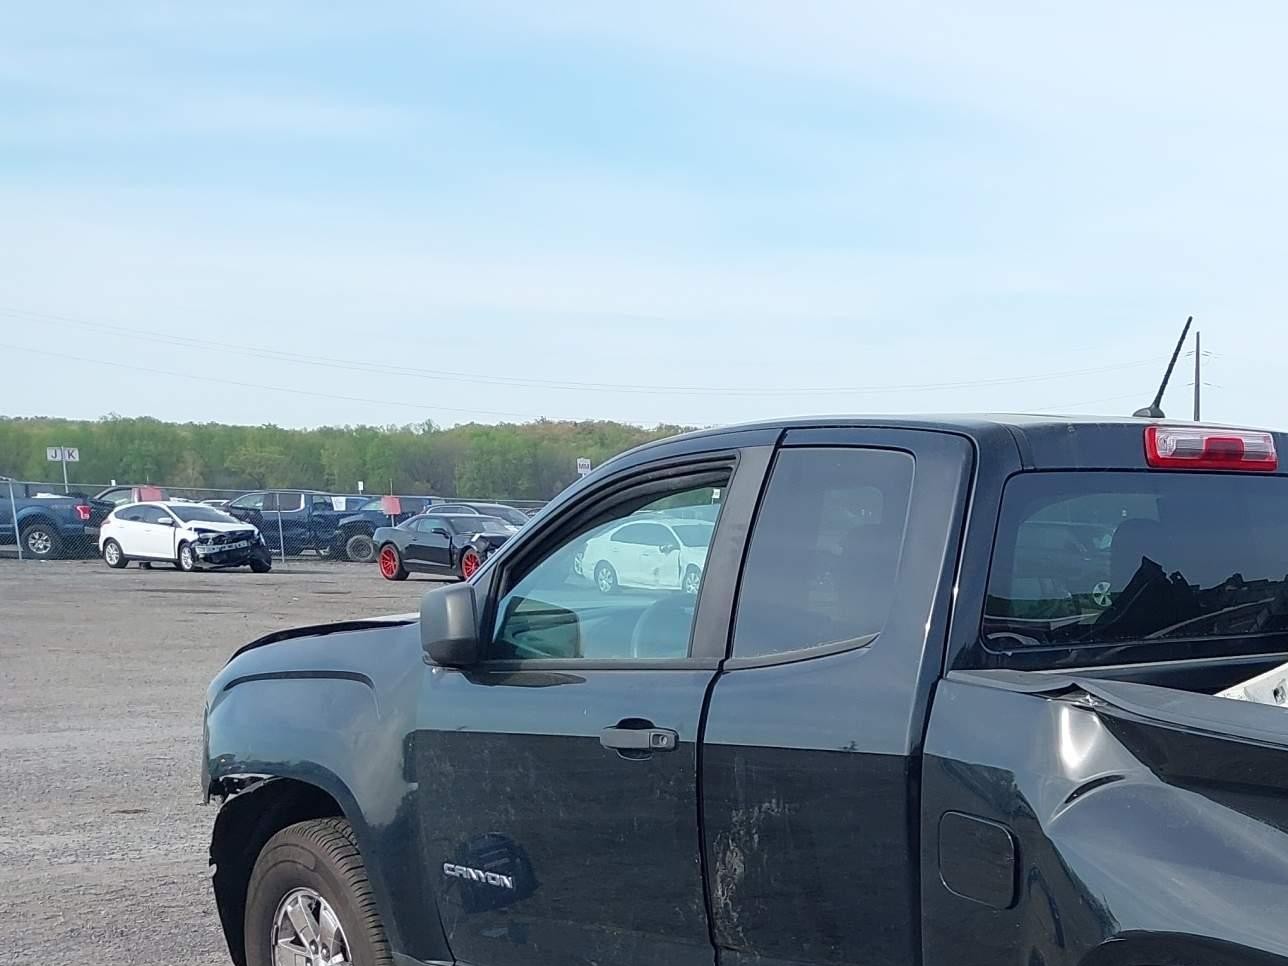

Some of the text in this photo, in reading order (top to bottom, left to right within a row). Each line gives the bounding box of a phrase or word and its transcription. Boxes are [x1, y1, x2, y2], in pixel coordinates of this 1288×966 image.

[51, 449, 76, 459] J K
[443, 862, 513, 888] CANYON
